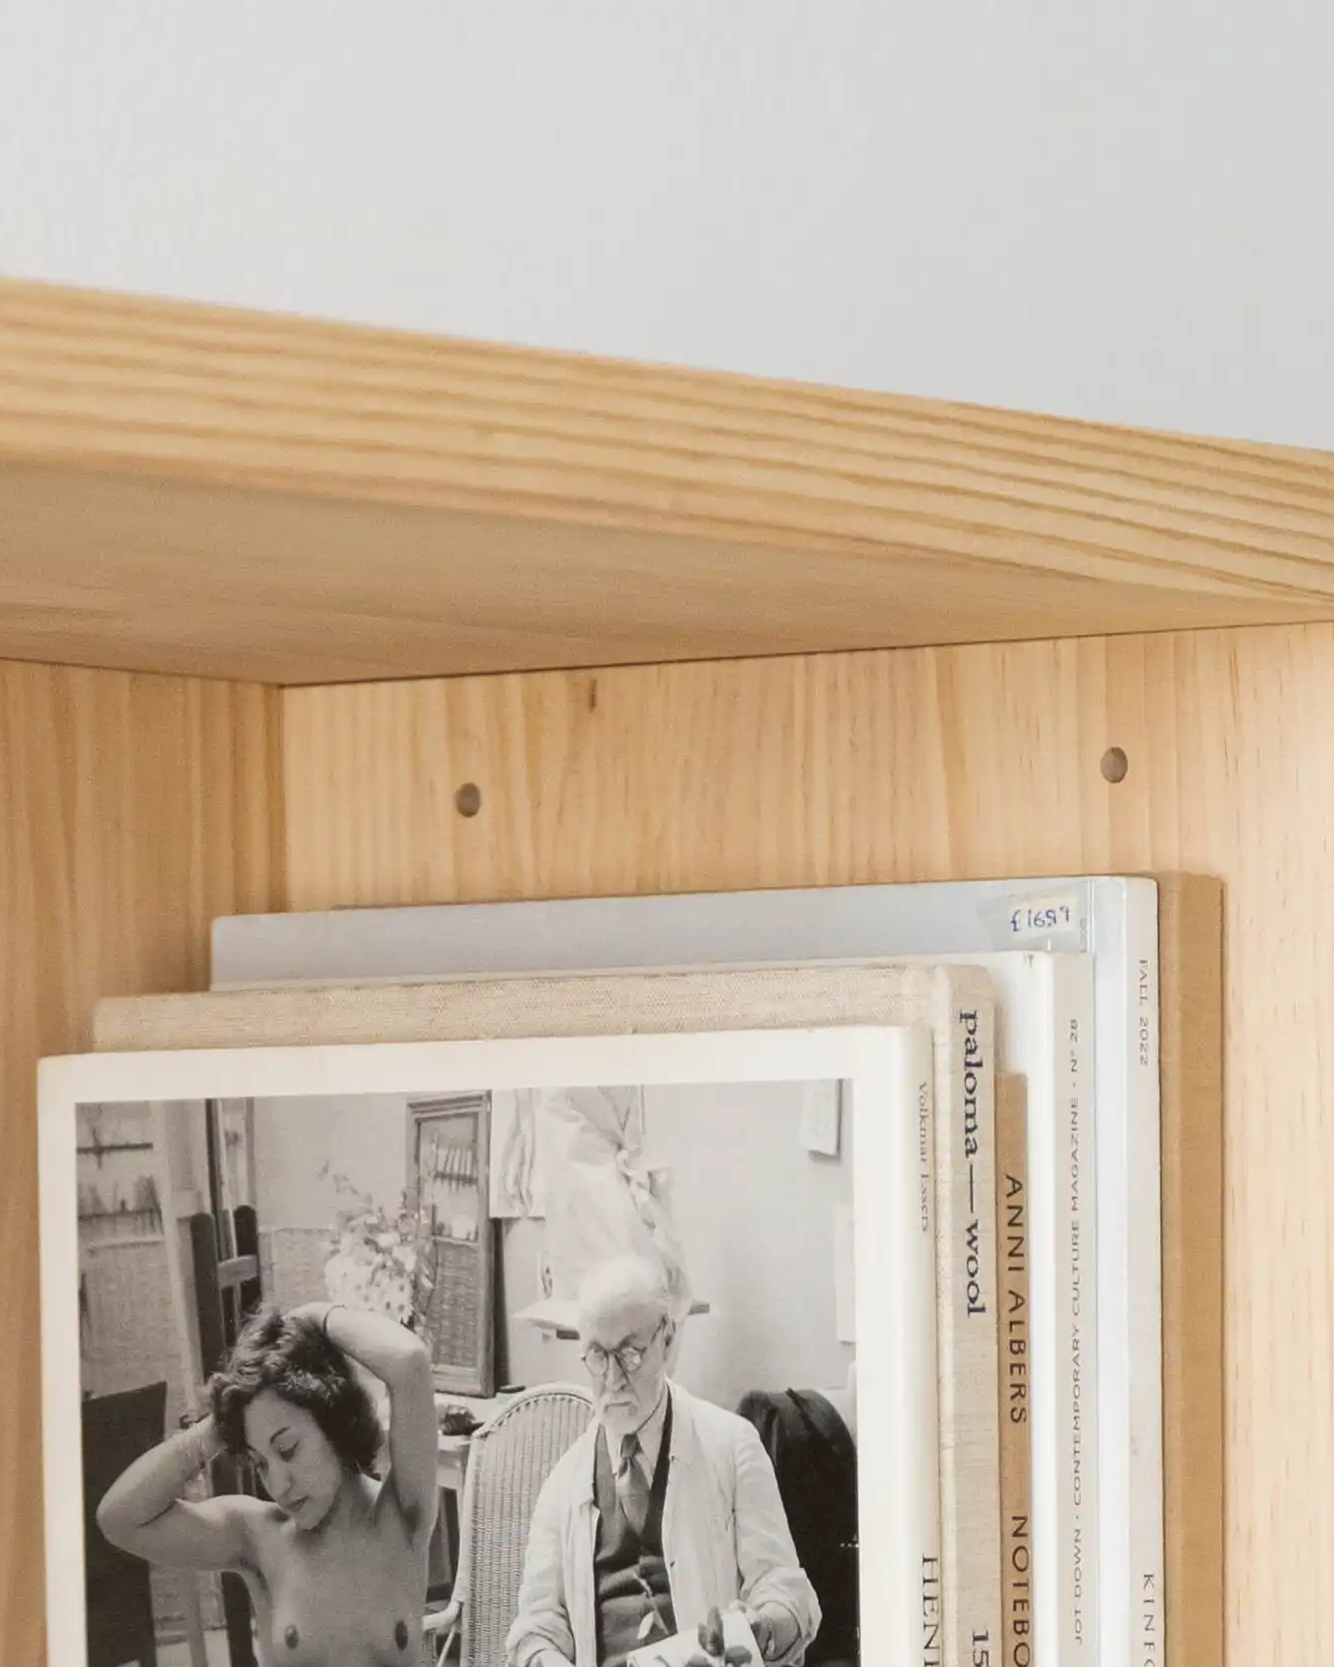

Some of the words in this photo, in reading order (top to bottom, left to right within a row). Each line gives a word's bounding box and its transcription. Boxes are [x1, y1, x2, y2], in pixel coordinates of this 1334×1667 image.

[1138, 959, 1149, 1005] FALL
[1139, 1016, 1149, 1066] 2022
[918, 1081, 929, 1163] Volkmar
[1070, 1098, 1079, 1212] MAGAZINE
[1005, 1173, 1025, 1272] ANNI
[1070, 1220, 1080, 1317] CULTURE
[1007, 1289, 1027, 1424] ALBERS
[1071, 1324, 1082, 1507] CONTEMPORARY
[1073, 1528, 1082, 1599] DOWN
[1073, 1608, 1083, 1645] JOT
